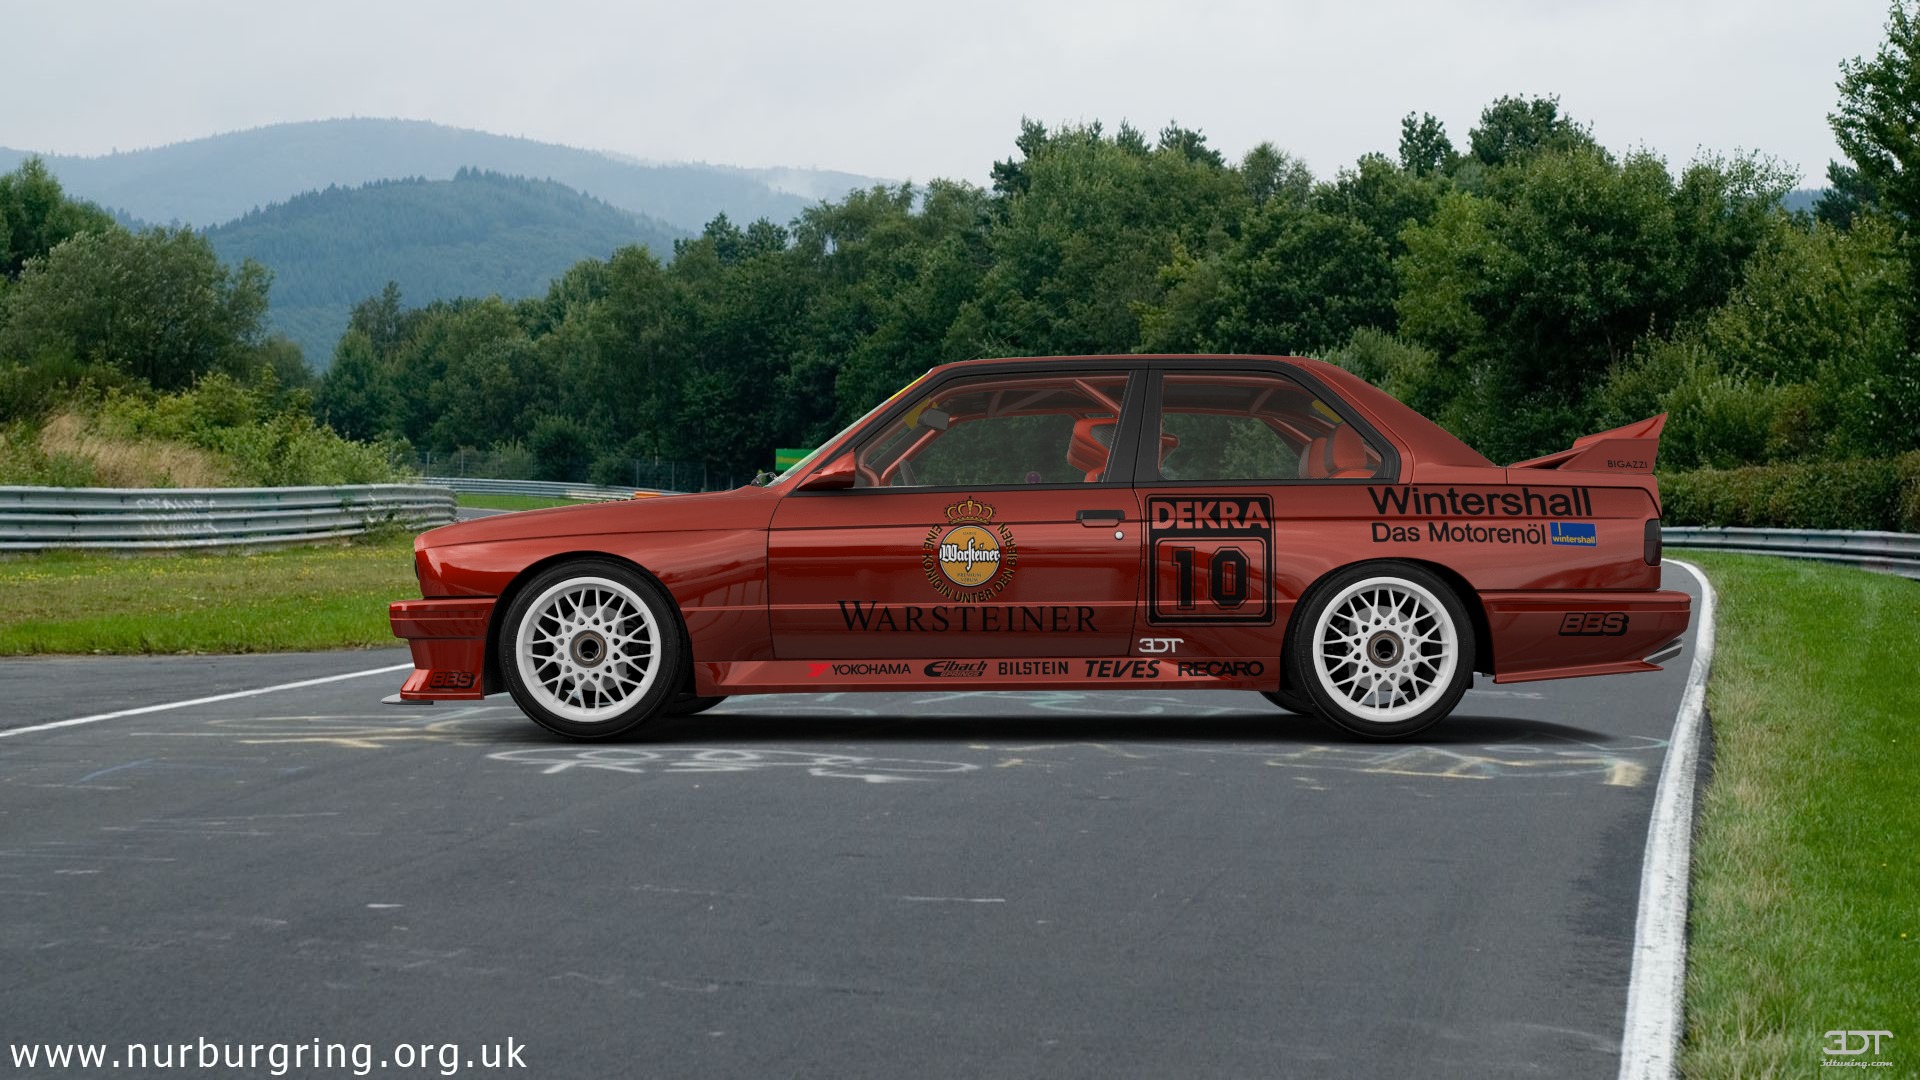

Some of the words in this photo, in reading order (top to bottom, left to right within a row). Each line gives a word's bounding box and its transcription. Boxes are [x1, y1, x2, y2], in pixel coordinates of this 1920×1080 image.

[1607, 459, 1648, 469] BIGAZZI
[1367, 486, 1593, 517] Wintershall
[1151, 501, 1270, 530] DEKRA
[923, 523, 943, 551] EINE
[996, 523, 1018, 566] BIEREN
[1371, 522, 1421, 543] Das
[1428, 521, 1547, 545] Motorenöl
[1552, 535, 1596, 544] wintershall
[939, 537, 1001, 573] Warsteiner
[922, 553, 954, 599] KÖNIGIN
[994, 568, 1015, 592] DEN
[1172, 546, 1251, 610] 10
[954, 588, 996, 603] UNTER
[837, 600, 1100, 633] WARSTEINER
[1558, 612, 1630, 636] BBS
[1138, 637, 1185, 653] 3DT
[429, 671, 475, 689] BBS
[832, 663, 912, 676] YOKOHAMA
[923, 660, 988, 677] Eibach
[998, 661, 1069, 676] BILSTEIN
[1084, 659, 1161, 679] TEVES
[1177, 660, 1265, 678] RECARO
